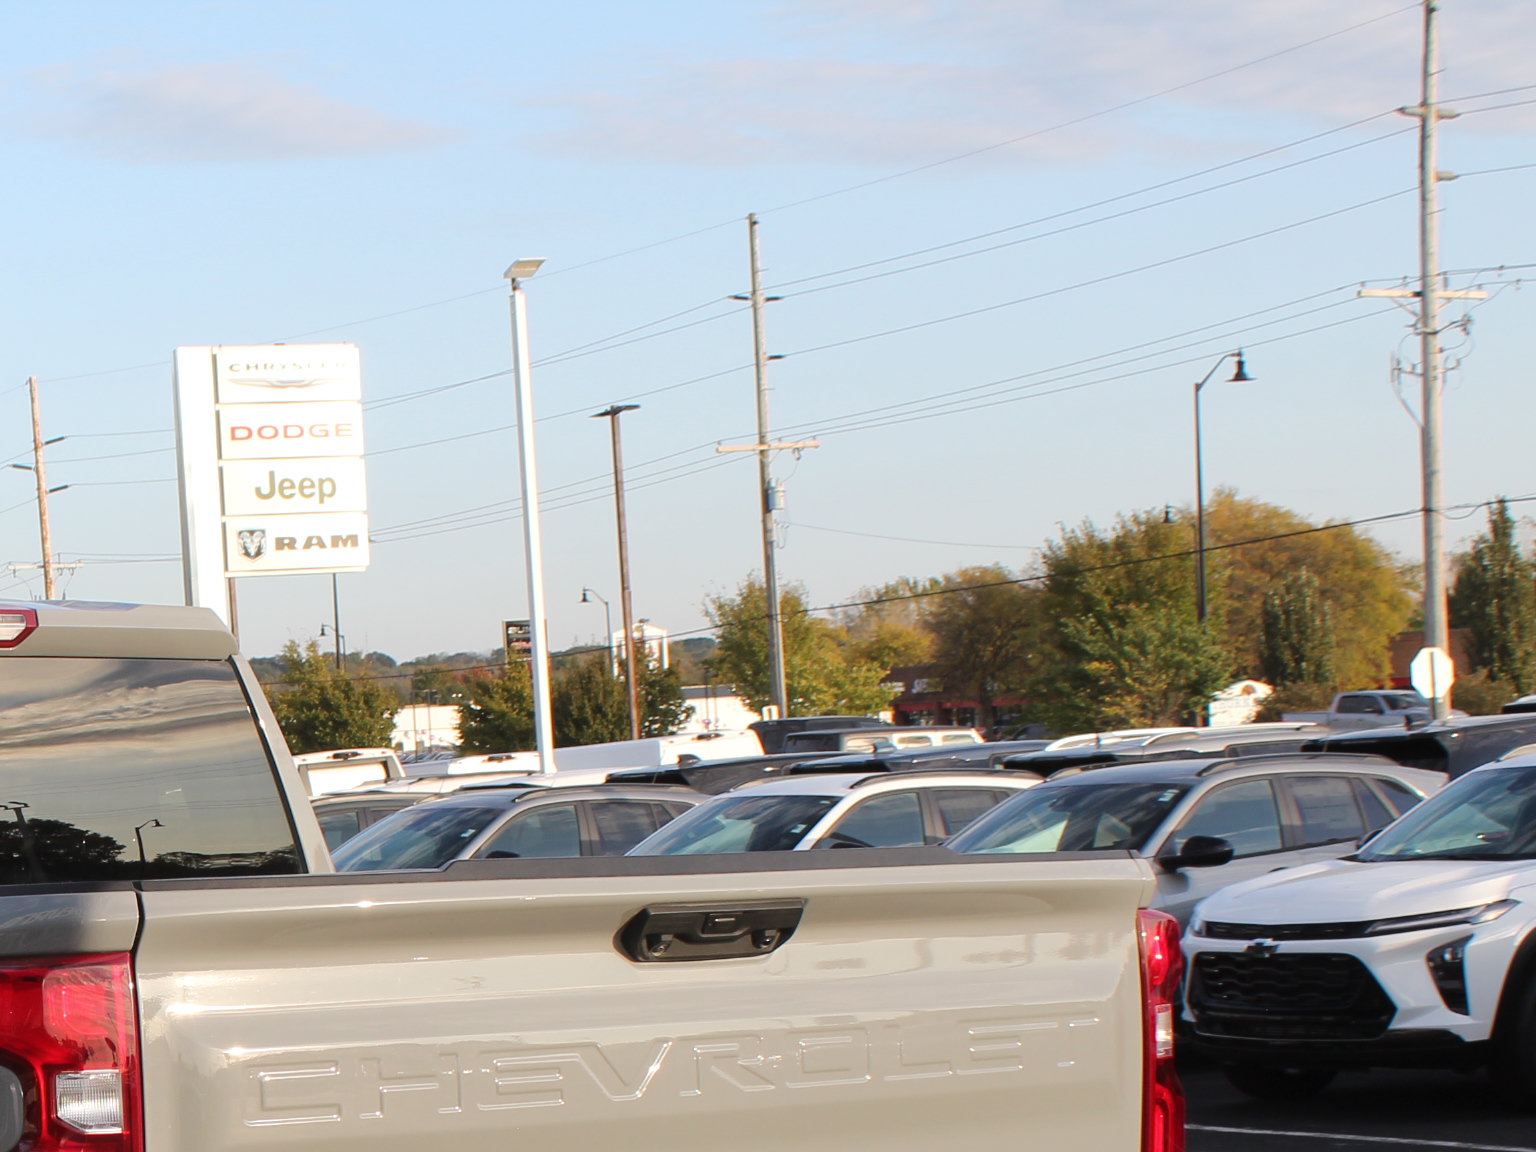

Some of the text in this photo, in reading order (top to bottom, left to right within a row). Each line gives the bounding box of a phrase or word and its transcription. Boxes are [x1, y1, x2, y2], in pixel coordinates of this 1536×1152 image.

[230, 423, 353, 441] DODGE
[254, 470, 337, 505] Jeep
[274, 534, 360, 551] RAM
[242, 1010, 1105, 1128] CHEVROLET
